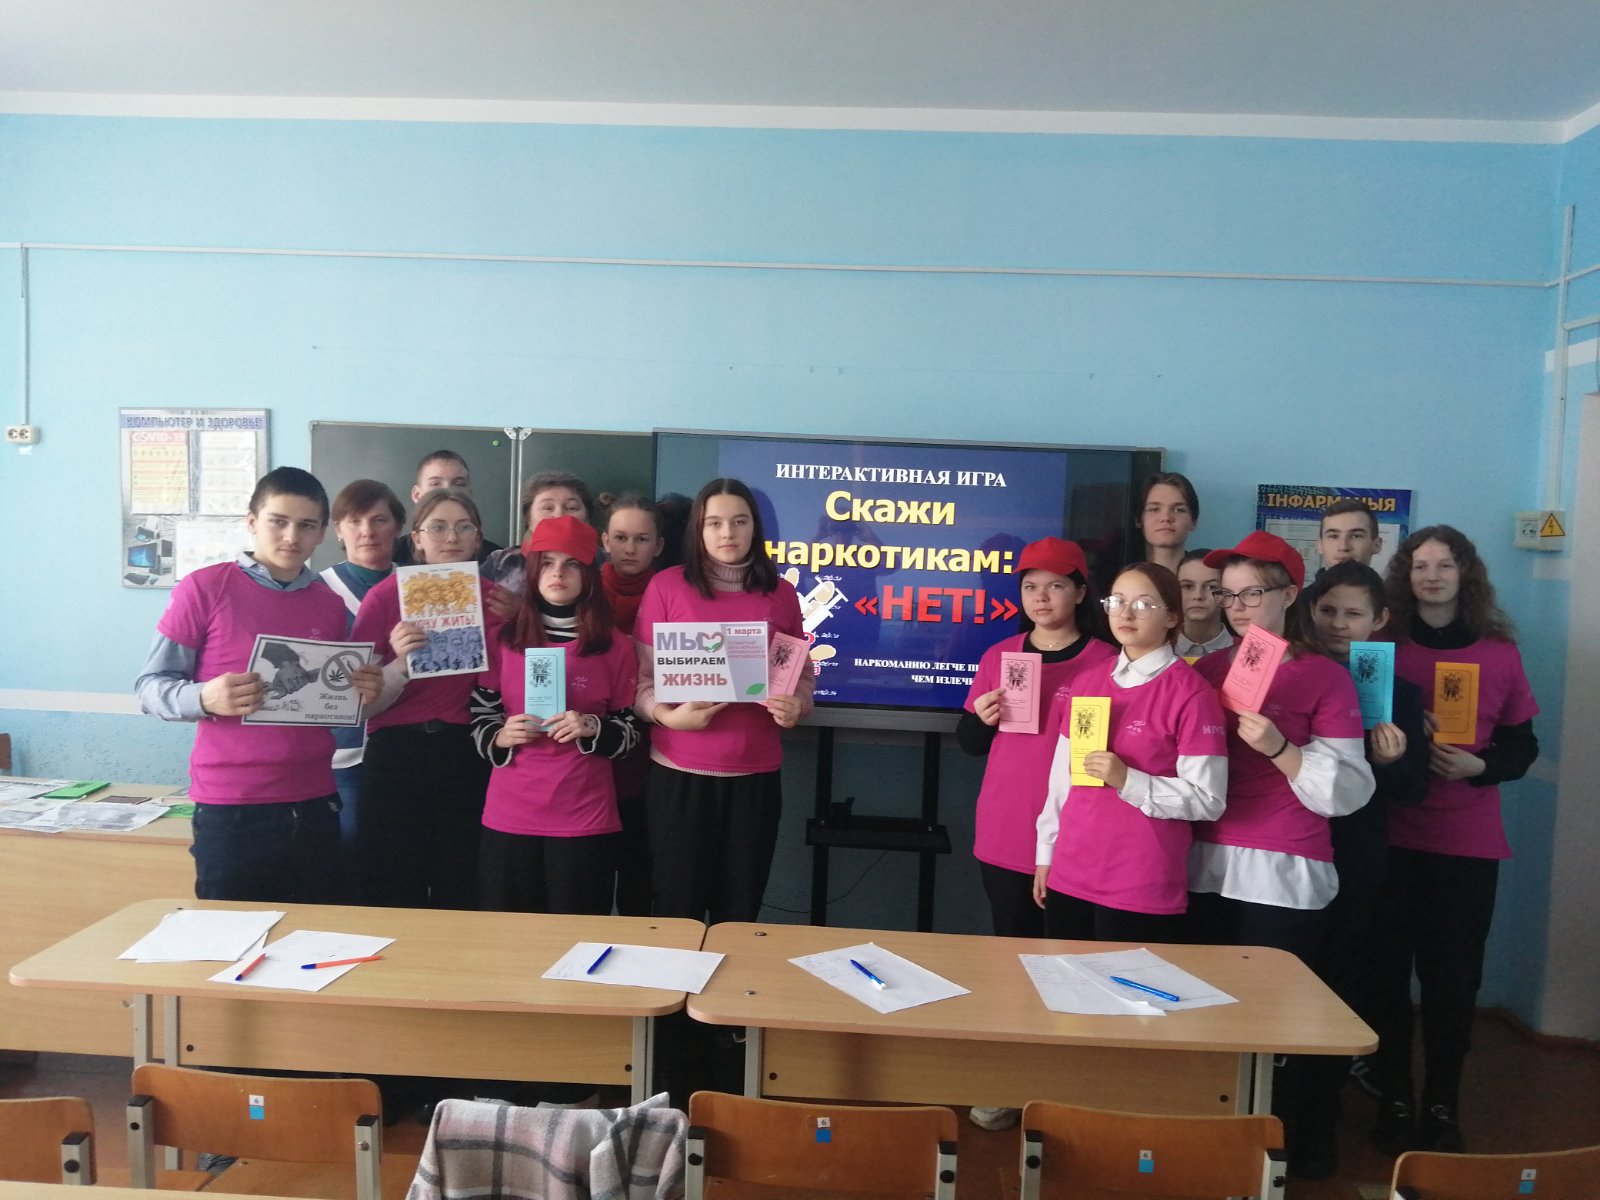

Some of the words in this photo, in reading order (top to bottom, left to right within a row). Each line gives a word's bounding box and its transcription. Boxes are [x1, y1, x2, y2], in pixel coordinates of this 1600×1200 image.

[126, 416, 193, 429] КОМПЬЮТЕР
[196, 417, 205, 429] И
[132, 431, 186, 442] COVID-19
[775, 463, 951, 486] ИНТЕРАКТИВНАЯ
[956, 471, 1007, 488] ИГРА
[825, 490, 956, 525] Скажи
[1266, 493, 1396, 512] ІНФАРМЫЯ
[764, 540, 1014, 574] наркотикам:
[854, 584, 1019, 625] «НЕТ!»
[726, 627, 731, 635] 1
[734, 628, 762, 636] марта
[657, 656, 726, 666] ВЫБИРАЕМ
[854, 658, 931, 670] НАРКОМАНИЮ
[931, 661, 966, 672] ЛЕГЧЕ
[662, 672, 728, 687] ЖИЗНЬ
[911, 674, 935, 684] ЧЕМ
[324, 702, 338, 710] без
